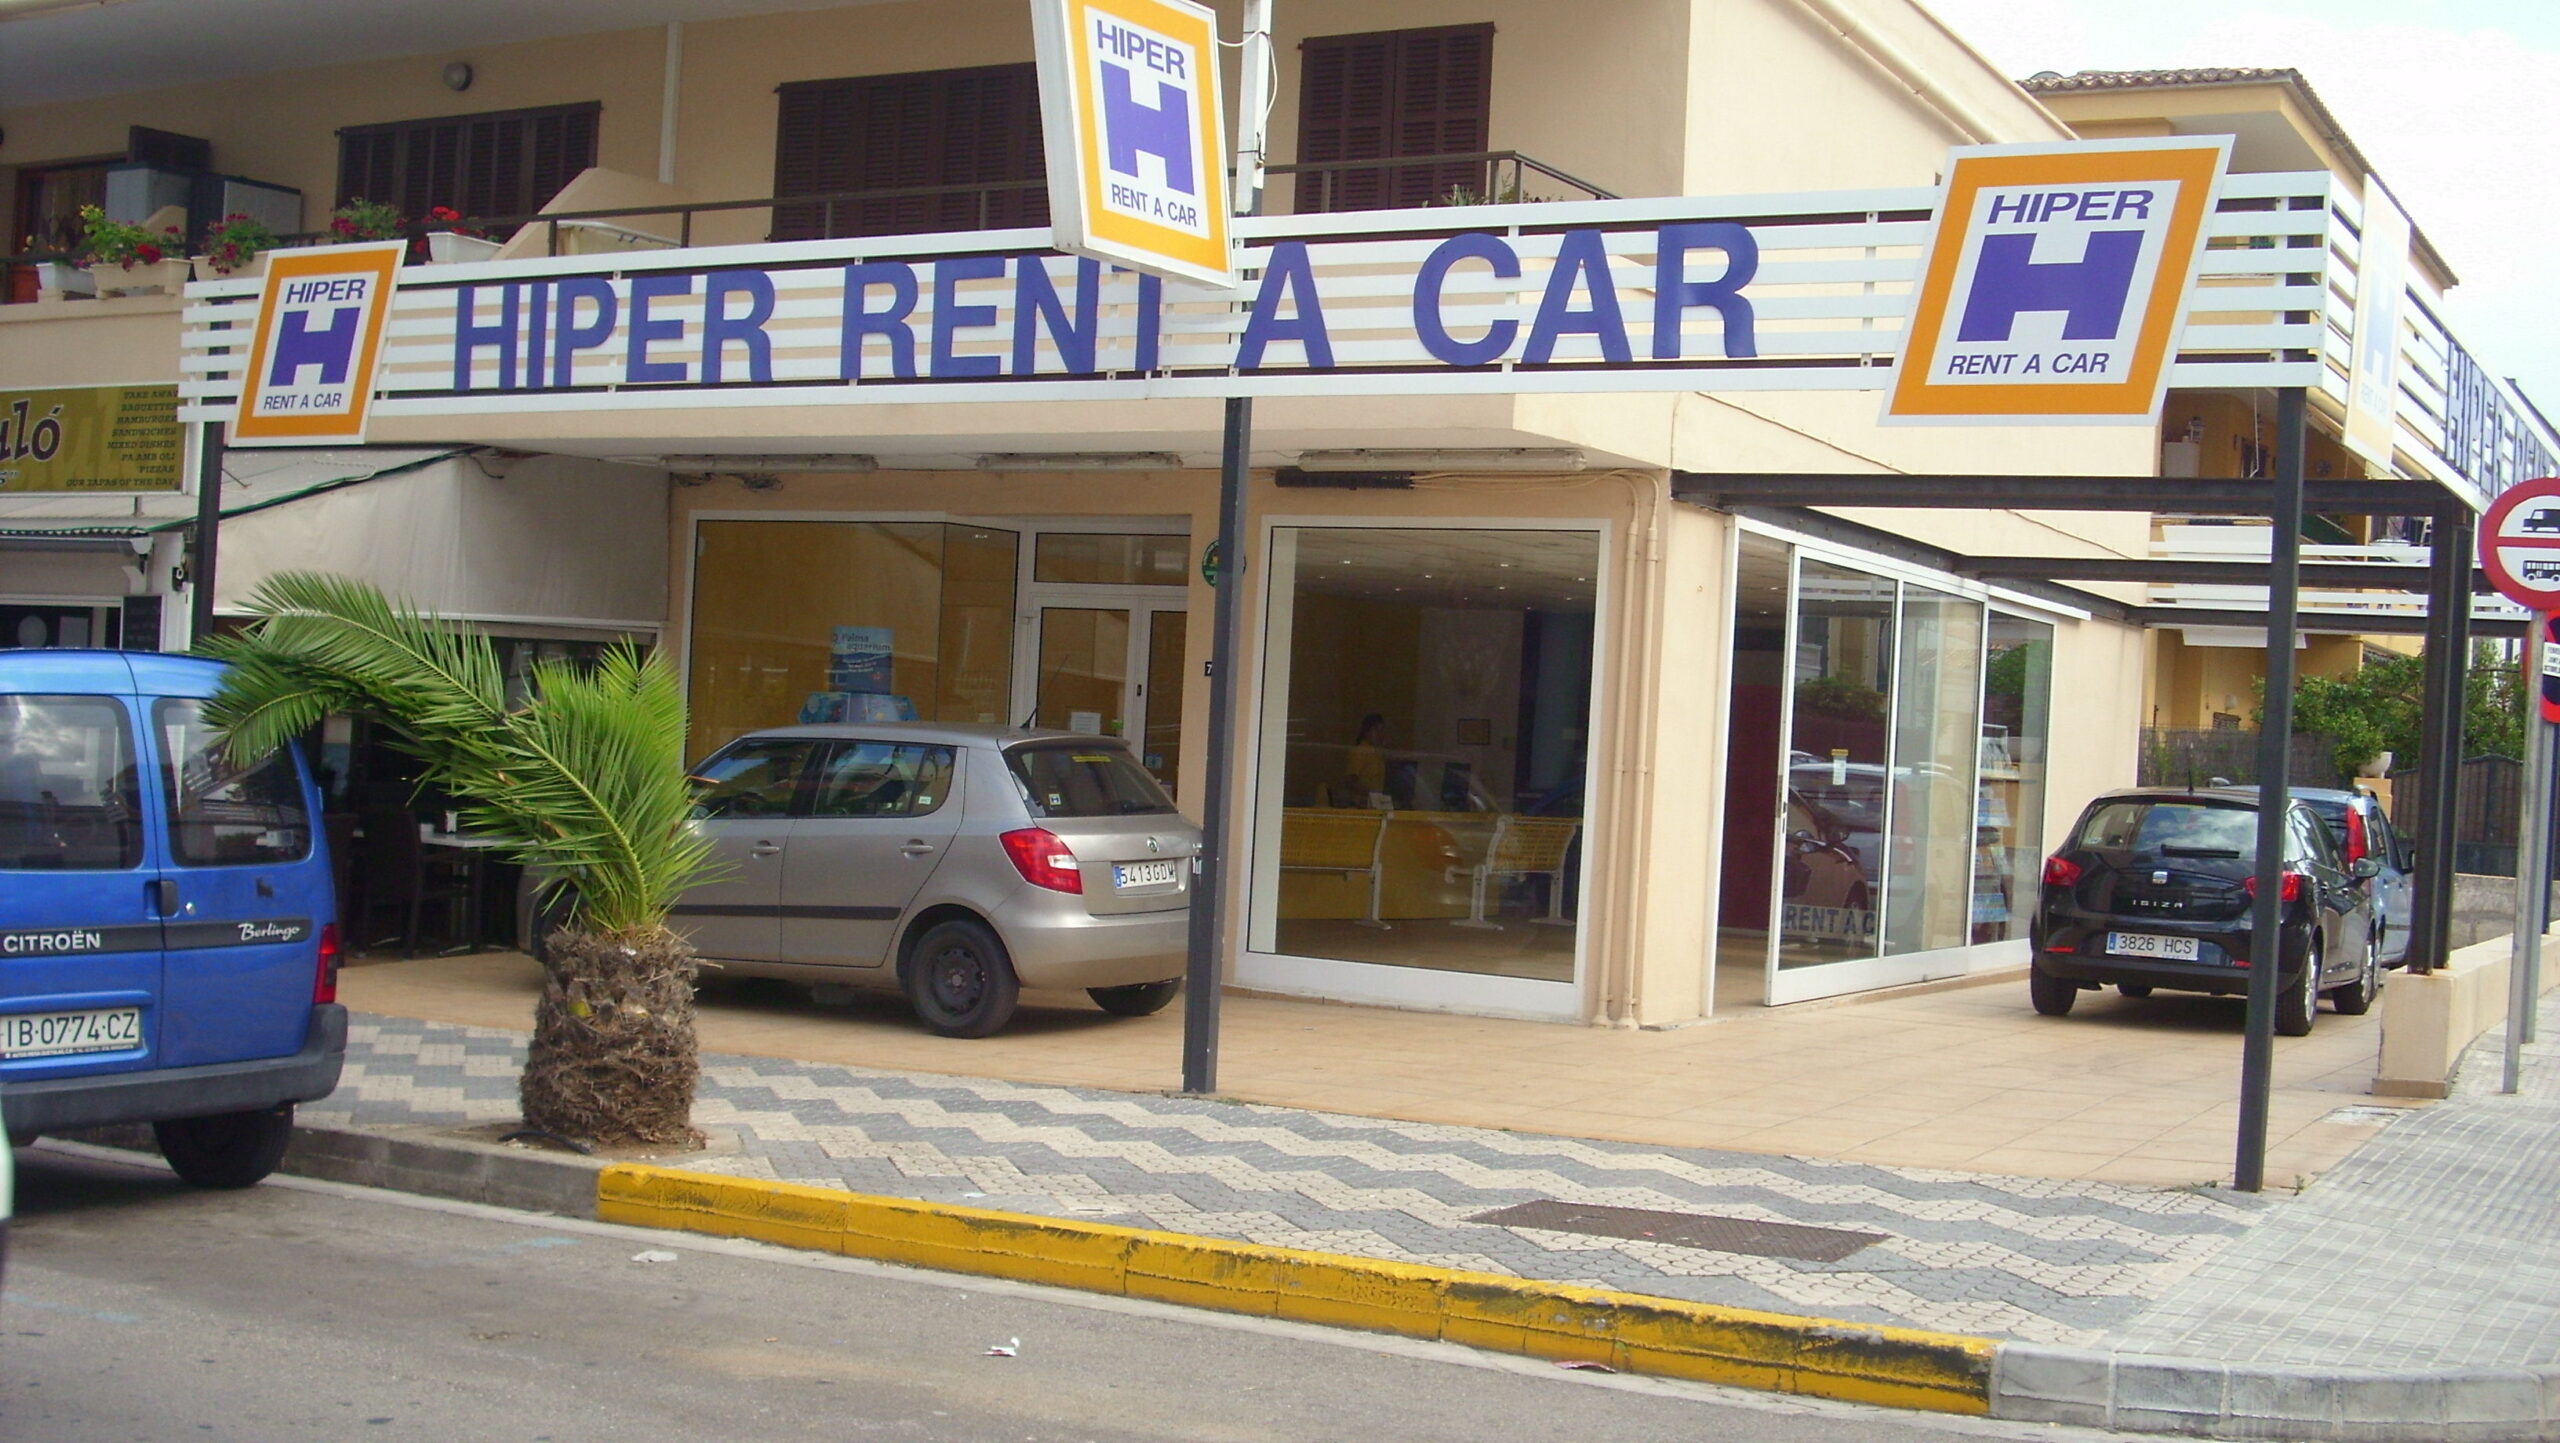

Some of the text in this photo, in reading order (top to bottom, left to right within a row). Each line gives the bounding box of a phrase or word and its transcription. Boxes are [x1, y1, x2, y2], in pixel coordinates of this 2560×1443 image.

[1097, 20, 1186, 80] HIPER
[1100, 60, 1195, 196] H
[1111, 183, 1197, 228] RENT A CAR
[1987, 190, 2154, 224] HIPER
[286, 279, 366, 304] HIPER
[1957, 230, 2145, 342] H
[454, 270, 775, 392] HIPER
[1234, 242, 1335, 368] A
[1413, 222, 1758, 366] CAR
[269, 307, 360, 387] H
[1947, 353, 2110, 375] RENT A CAR
[264, 392, 342, 410] RENT A CAR
[238, 922, 300, 941] Berlingo
[1784, 905, 1838, 934] RENT
[1843, 910, 1857, 935] A
[3, 930, 101, 953] CITROËN
[2119, 935, 2193, 955] 3826 HCS
